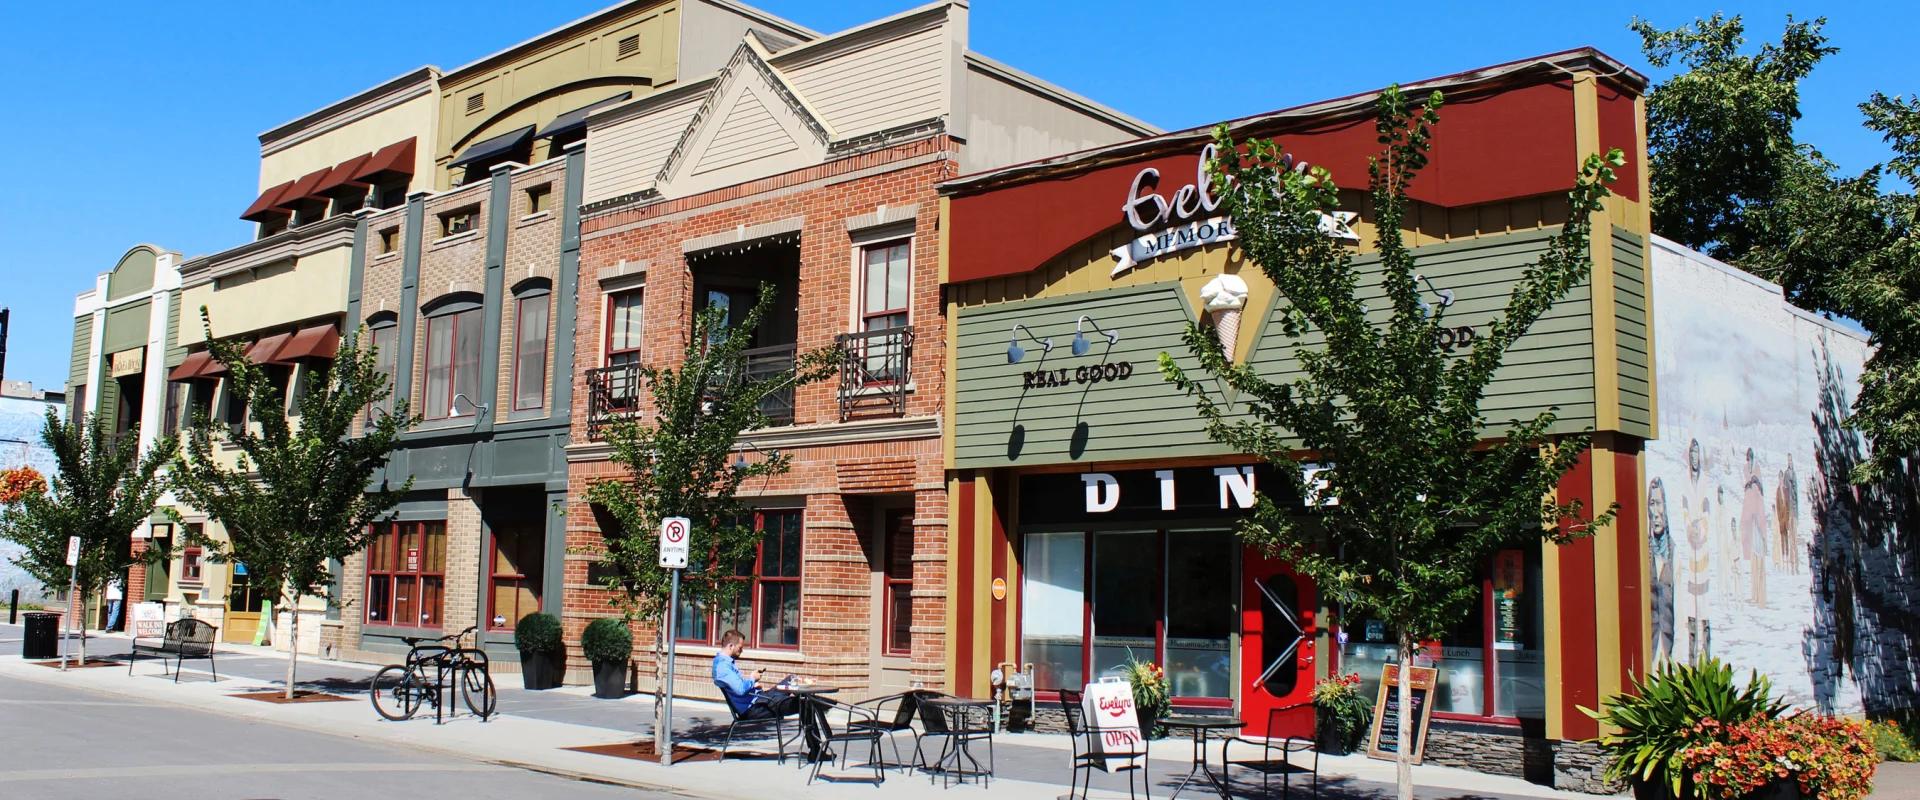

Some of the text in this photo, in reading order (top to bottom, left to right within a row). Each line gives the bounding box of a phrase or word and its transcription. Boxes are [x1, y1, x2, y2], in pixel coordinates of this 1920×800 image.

[1023, 361, 1133, 389] REAL GOOD
[1447, 649, 1470, 657] Lunch
[1105, 729, 1140, 747] OPEN
